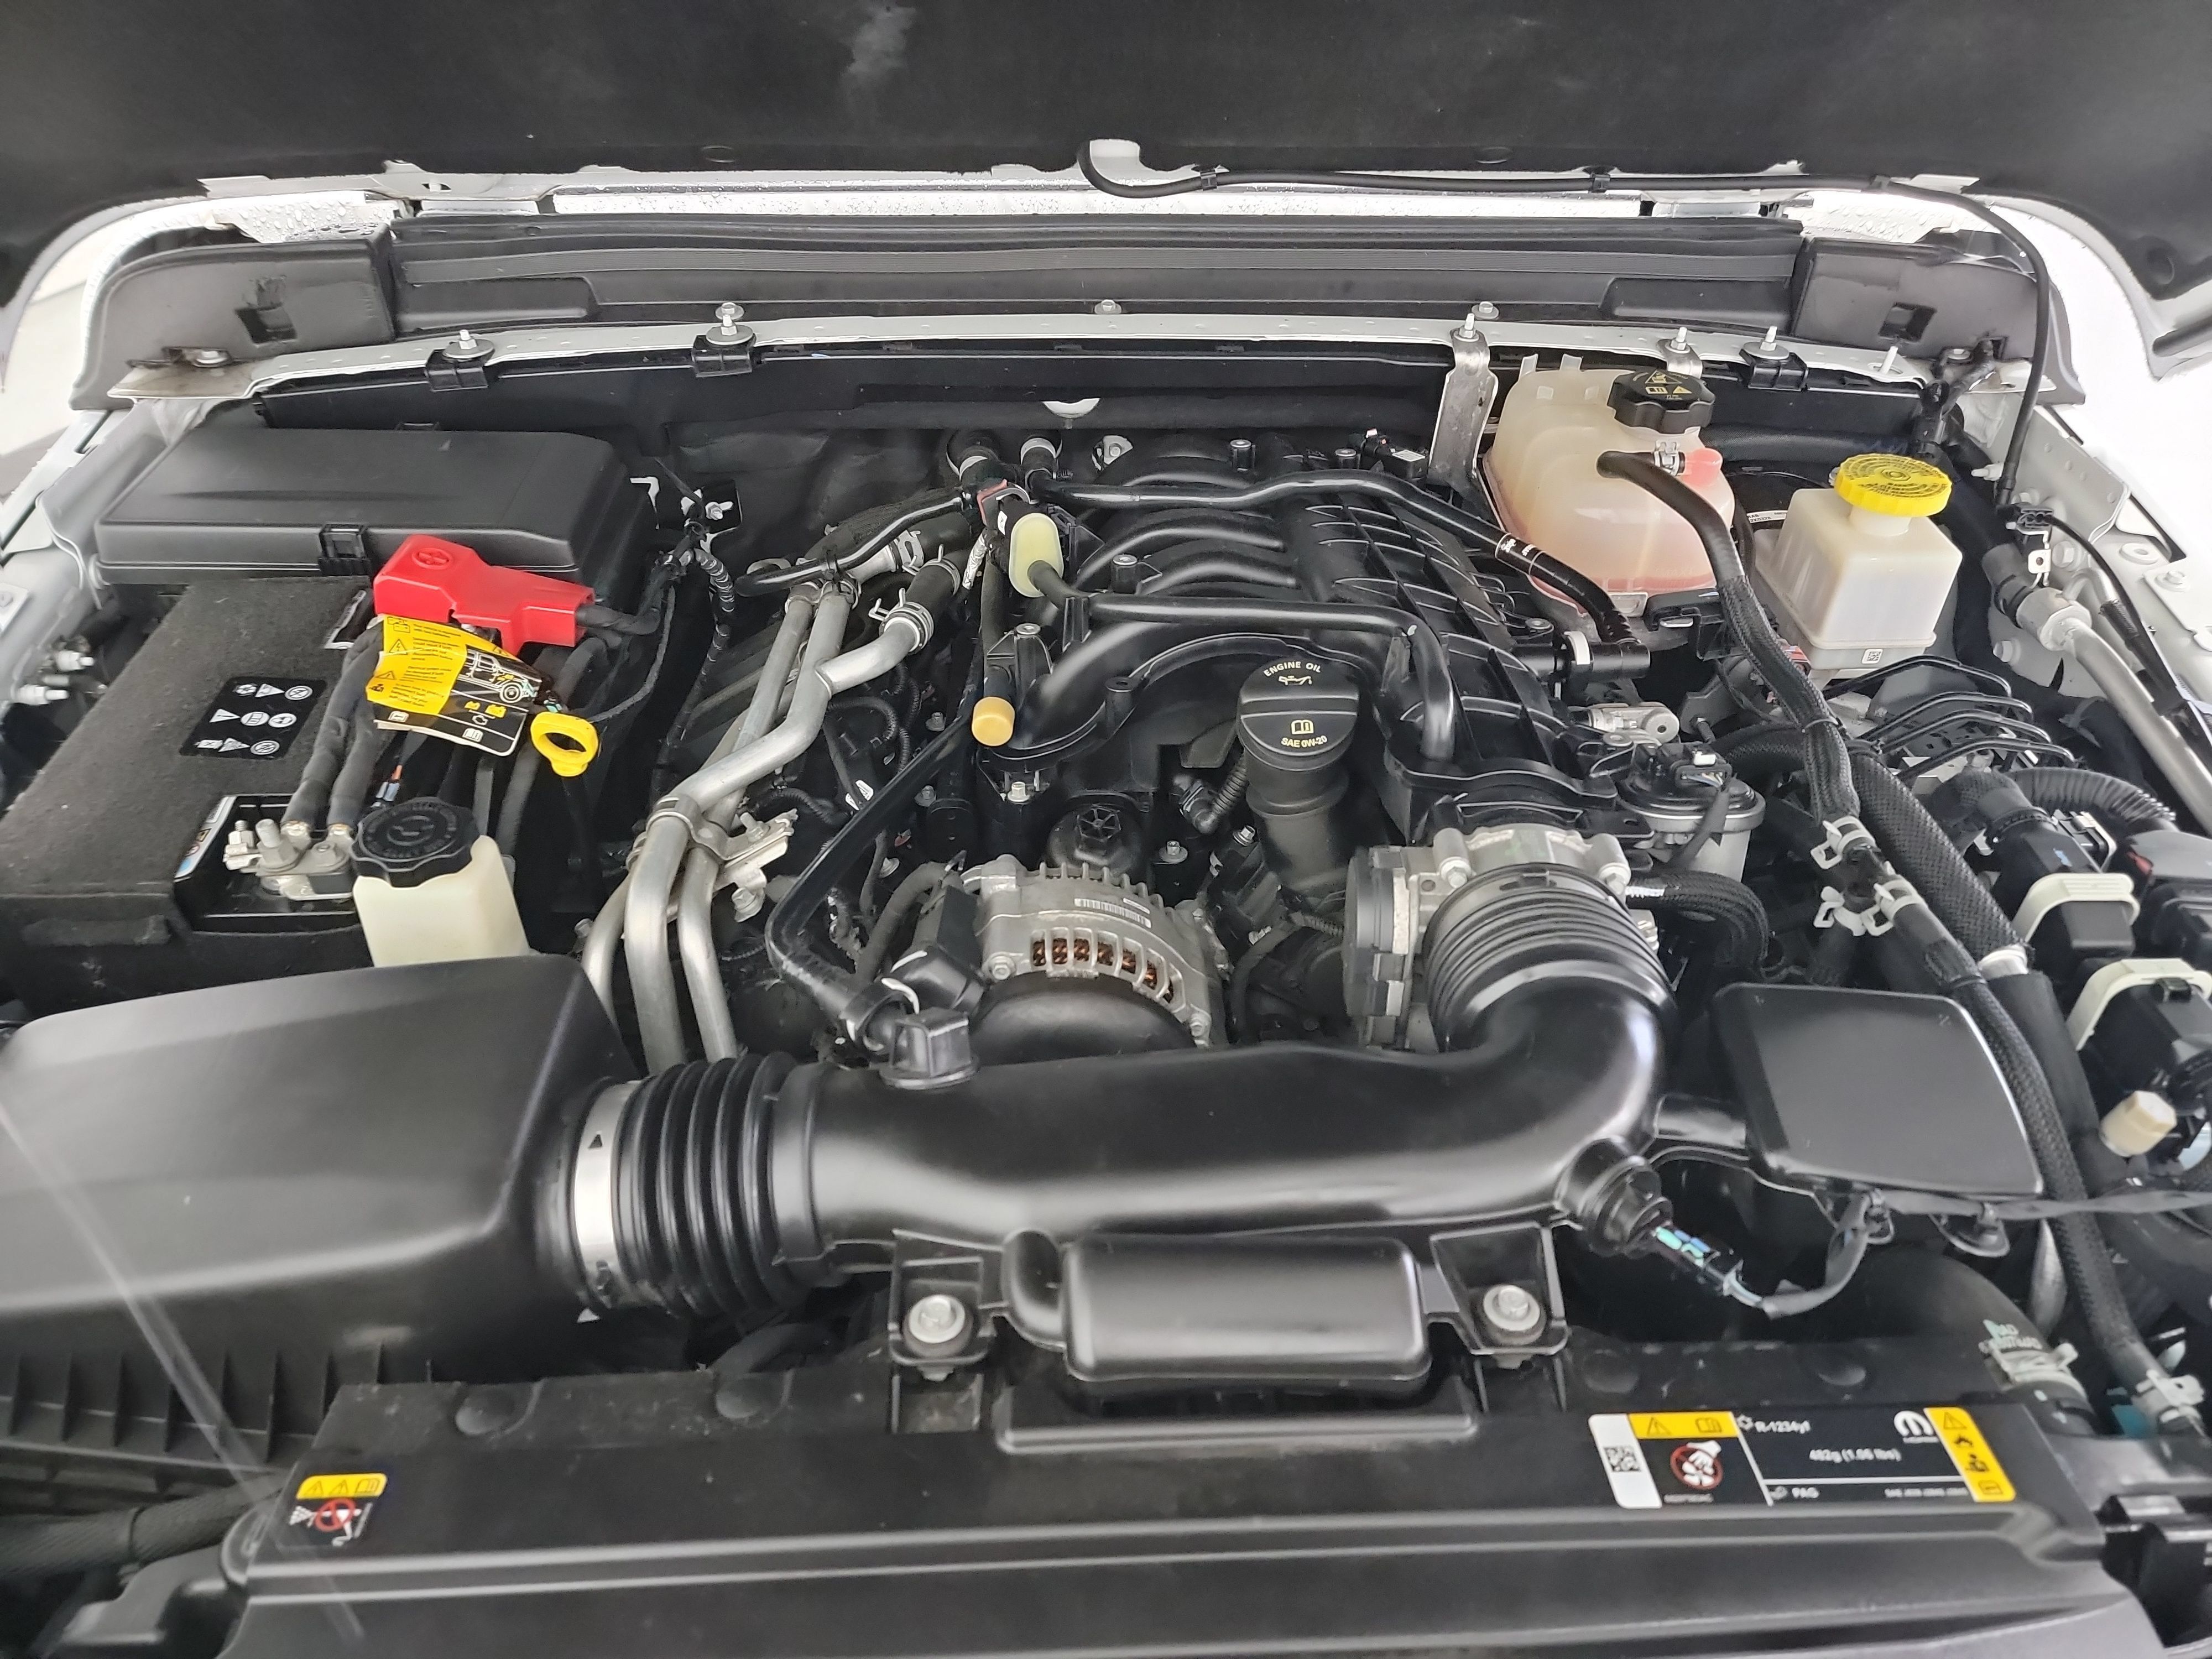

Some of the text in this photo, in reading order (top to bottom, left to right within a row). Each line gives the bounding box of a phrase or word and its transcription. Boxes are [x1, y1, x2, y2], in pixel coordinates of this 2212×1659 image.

[1263, 661, 1322, 677] ENGINE OIL
[1281, 735, 1328, 748] SAE 0W-20
